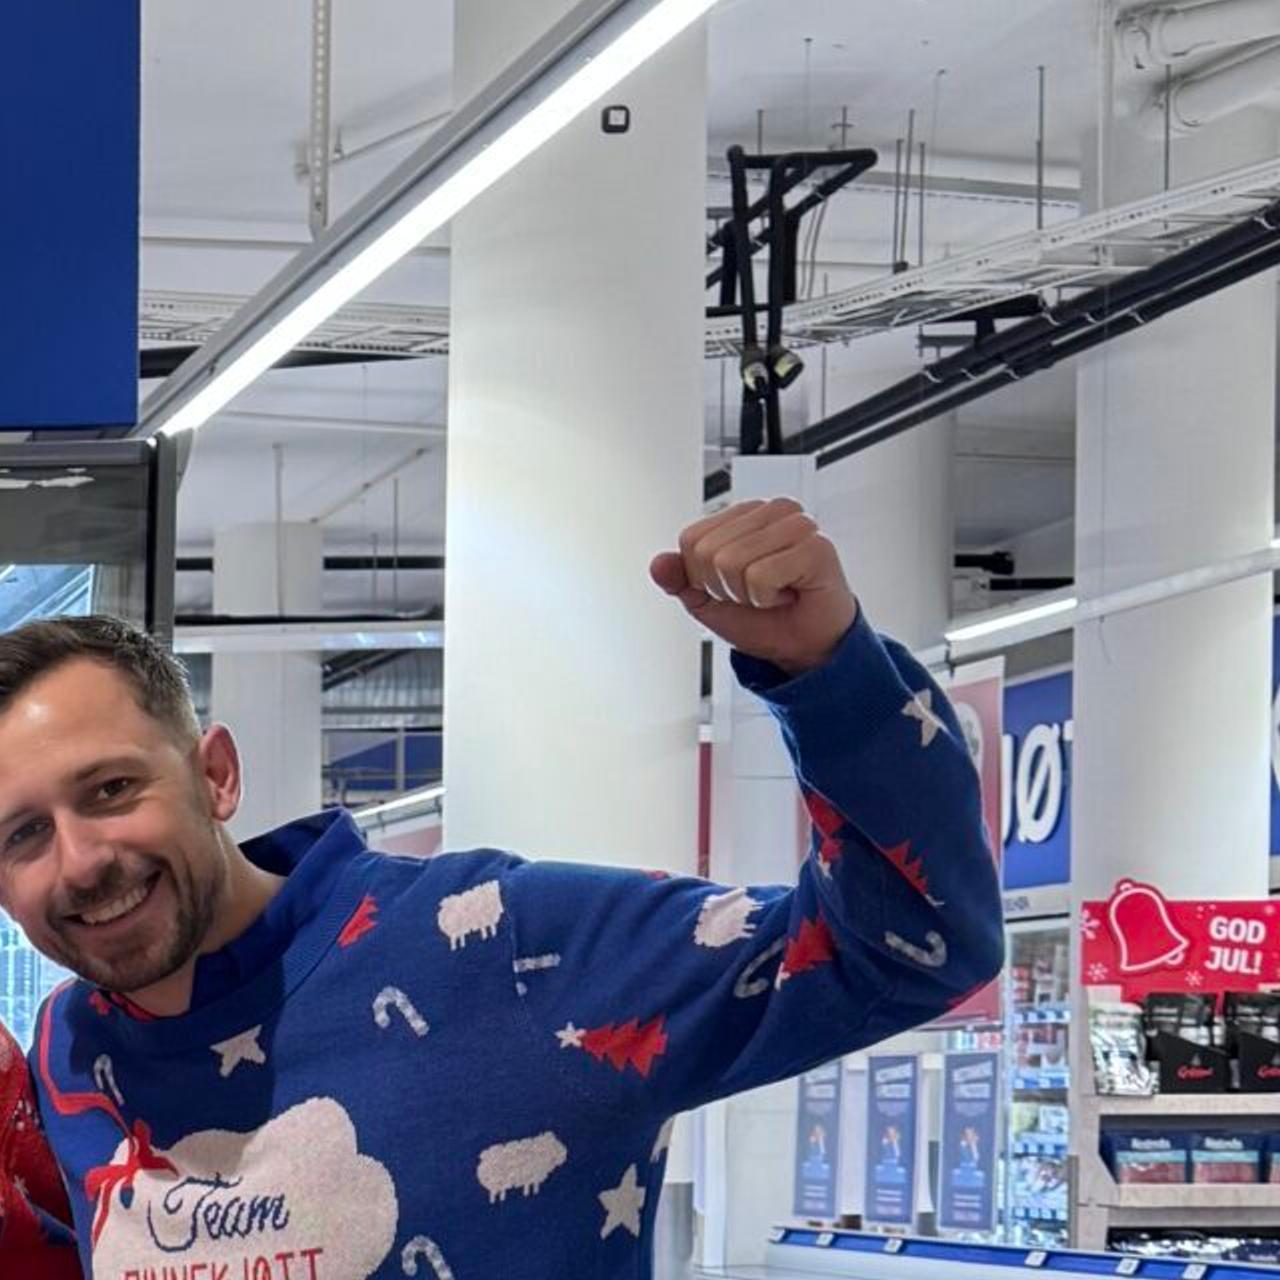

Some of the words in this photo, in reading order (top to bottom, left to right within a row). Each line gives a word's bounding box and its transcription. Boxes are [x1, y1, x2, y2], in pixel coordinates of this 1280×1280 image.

[1209, 916, 1266, 945] GOD
[1205, 946, 1263, 974] JUL!
[147, 1172, 291, 1253] Team
